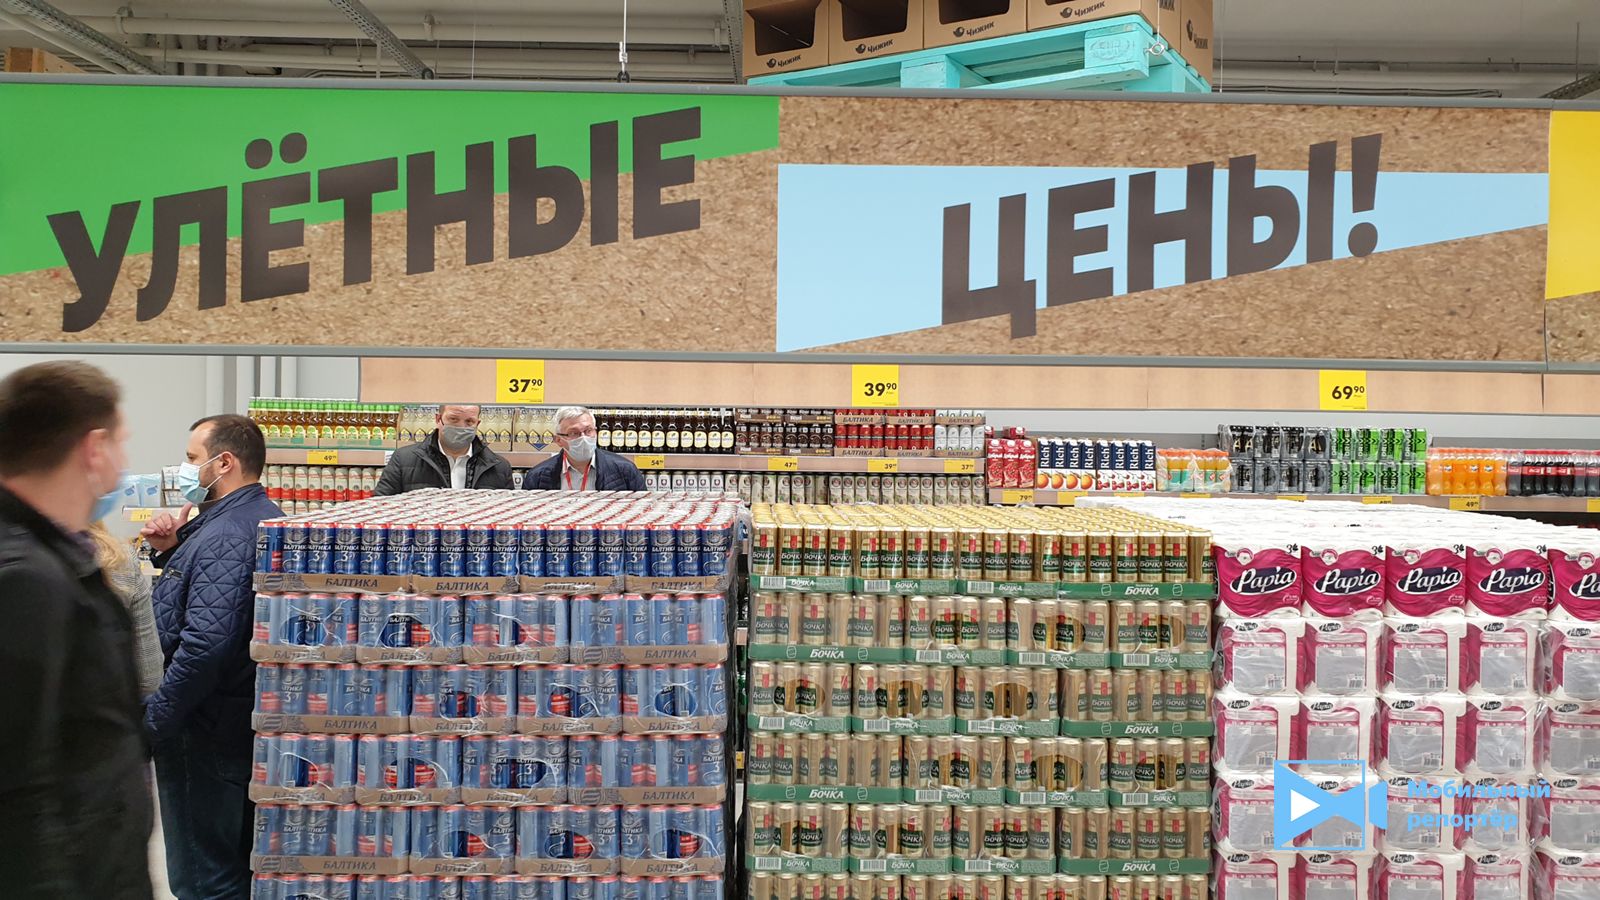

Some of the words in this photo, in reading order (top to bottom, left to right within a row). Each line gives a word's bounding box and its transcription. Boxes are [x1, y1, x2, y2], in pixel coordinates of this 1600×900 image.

[1074, 2, 1105, 17] Чижик
[966, 21, 994, 36] Чижик
[867, 39, 893, 52] Чижик
[778, 54, 801, 68] Чижик
[46, 106, 701, 332] УЛЁТНЫЕ
[942, 133, 1382, 340] ЦЕНЫ!
[326, 578, 378, 588] БАЛТИКА
[1238, 567, 1292, 593] Papia
[1321, 568, 1376, 594] Papia
[1404, 566, 1459, 593] Papia
[1486, 567, 1542, 593] Papia
[436, 582, 489, 590] БАЛТИКА
[1125, 587, 1159, 596] БОЧКА
[645, 650, 697, 659] БАЛТИКА
[810, 649, 844, 659] БОЧКА
[324, 720, 378, 730] БАЛТИКА
[1125, 725, 1159, 734] БОЧКА
[643, 792, 695, 800] БАЛТИКА
[809, 789, 844, 798] БОЧКА
[324, 862, 376, 870] БАЛТИКА
[1122, 863, 1156, 871] БОЧКА
